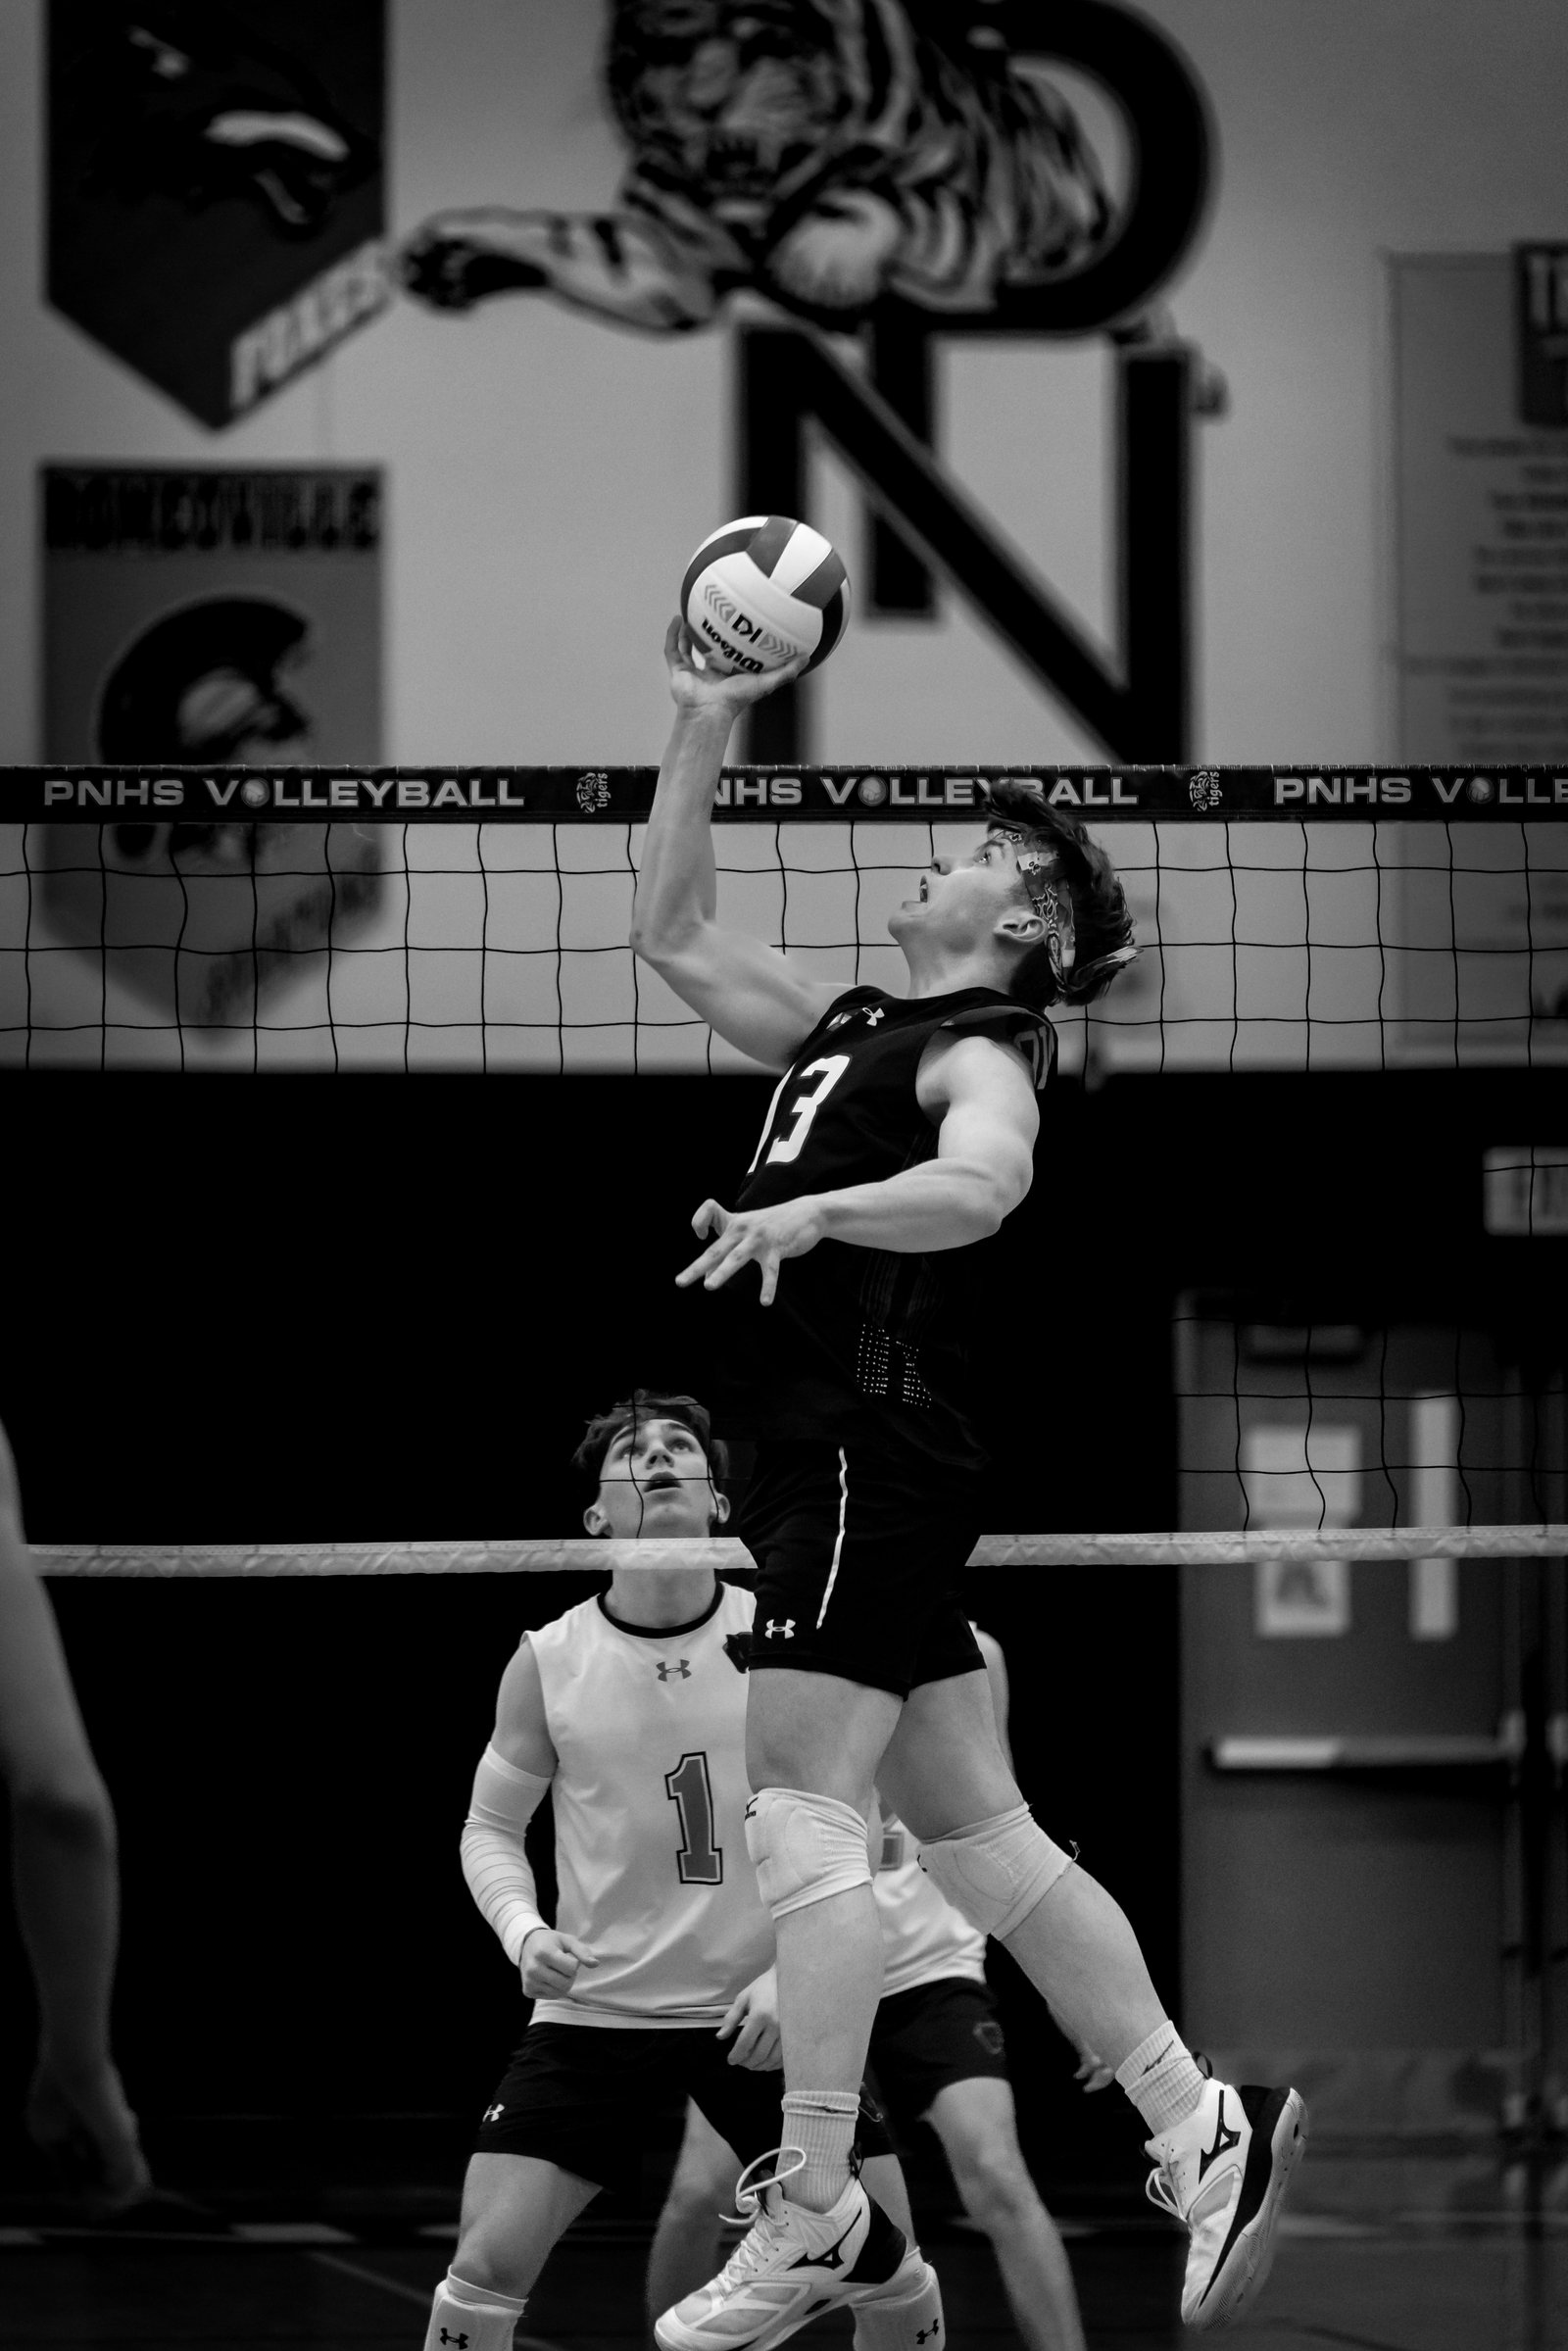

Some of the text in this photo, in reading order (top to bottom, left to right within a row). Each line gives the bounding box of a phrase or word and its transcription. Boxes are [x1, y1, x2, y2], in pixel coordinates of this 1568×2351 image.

[701, 618, 764, 674] Wilson
[43, 777, 525, 808] PNHS VOLLEYBALL
[594, 772, 612, 808] tigers
[713, 777, 804, 807] NHS
[1206, 770, 1223, 807] tigers
[1274, 776, 1413, 806] PNHS
[663, 1751, 723, 1886] 1
